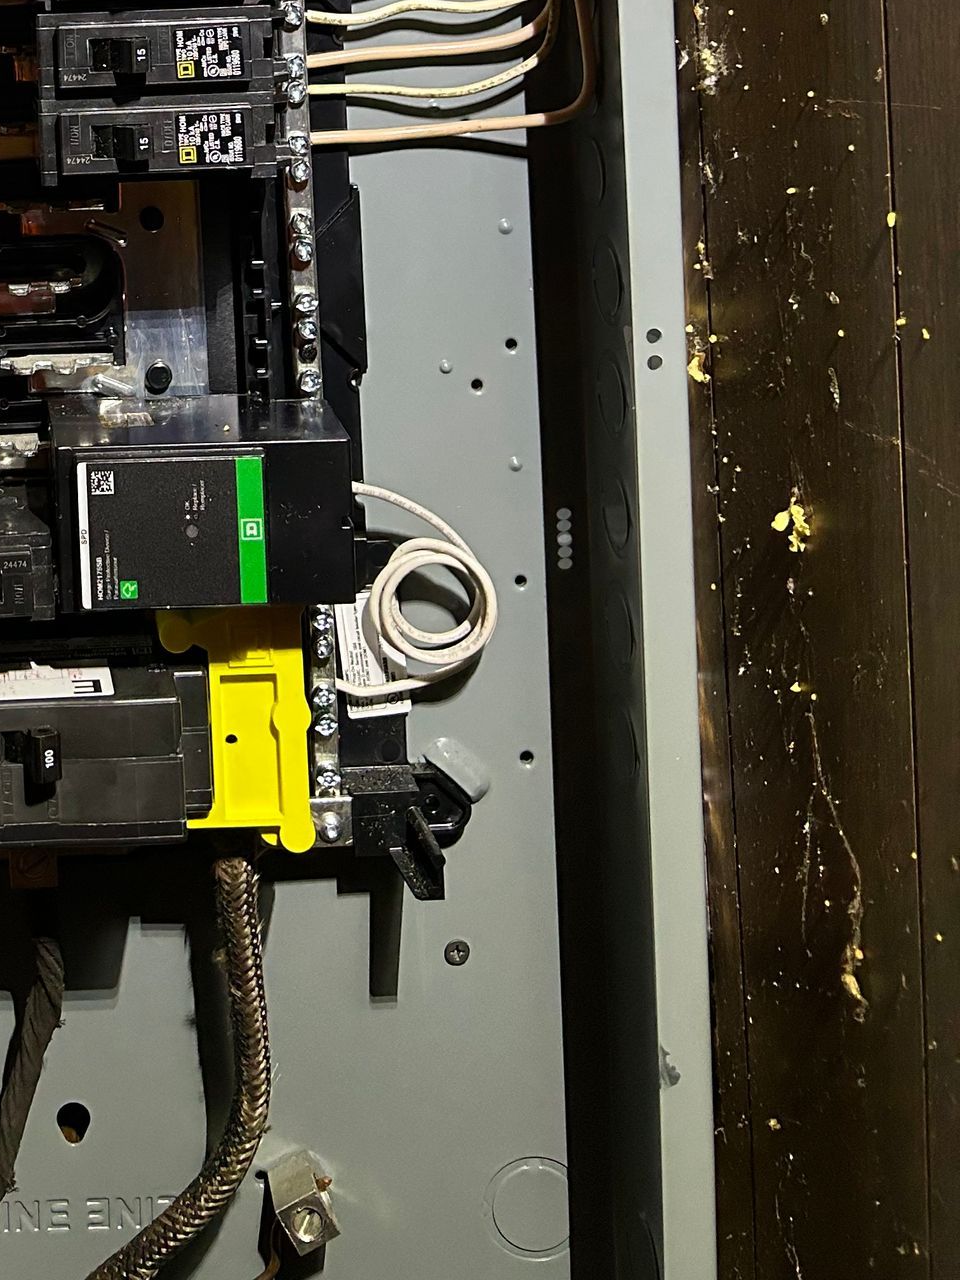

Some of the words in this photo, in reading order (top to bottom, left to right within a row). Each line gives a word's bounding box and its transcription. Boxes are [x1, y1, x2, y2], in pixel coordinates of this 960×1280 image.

[176, 31, 184, 47] HOM
[136, 47, 146, 62] 15
[64, 73, 87, 81] 24474
[139, 137, 149, 150] 15
[66, 156, 90, 165] 24474
[3, 560, 27, 569] 24474
[44, 749, 54, 769] 100
